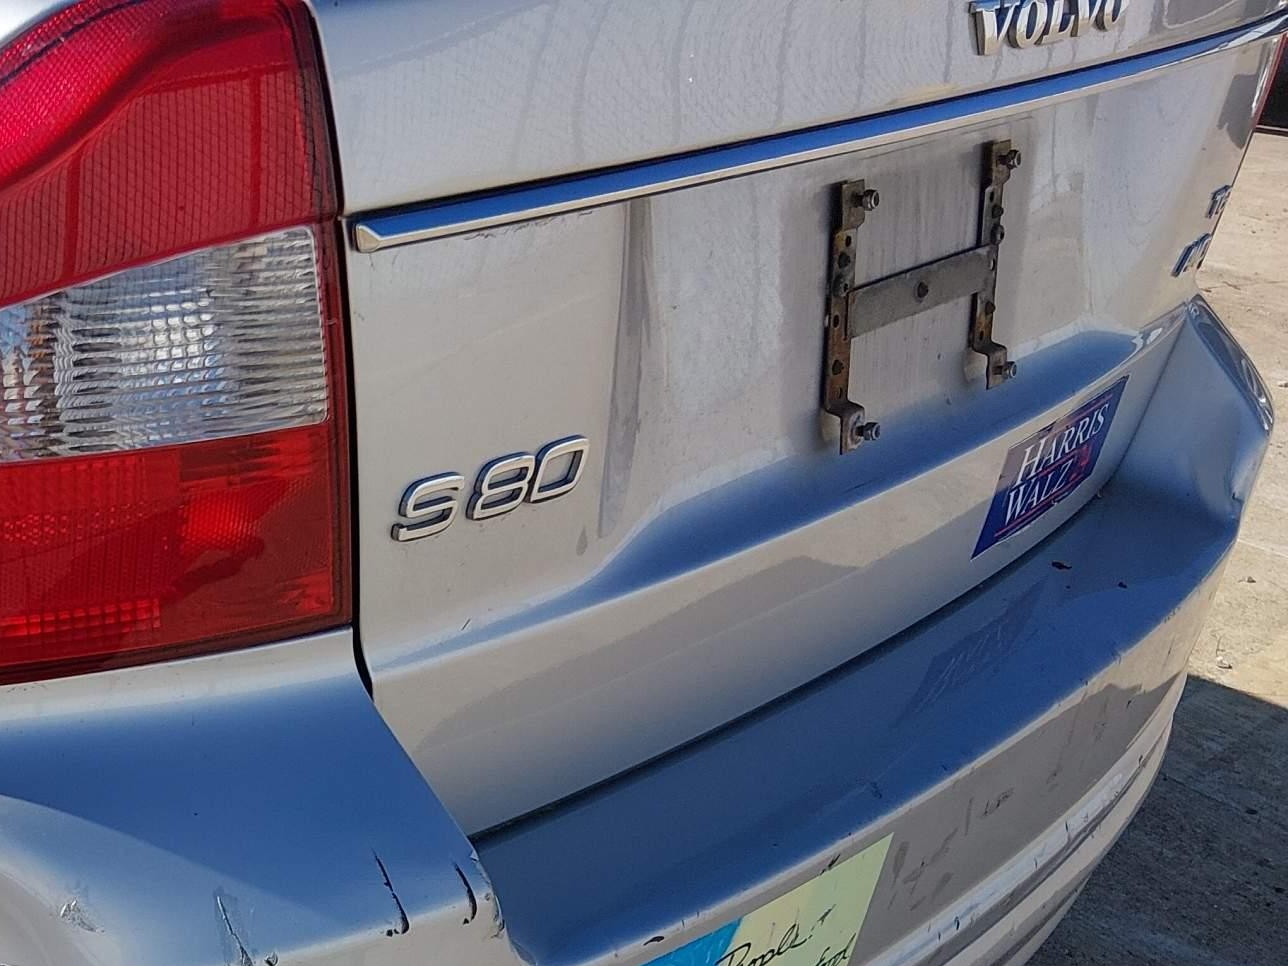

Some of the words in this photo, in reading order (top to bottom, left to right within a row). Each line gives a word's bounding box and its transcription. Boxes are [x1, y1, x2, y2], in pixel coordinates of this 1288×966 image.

[970, 0, 1128, 55] VOLVO
[1013, 403, 1109, 487] HARRIS
[391, 434, 589, 541] S80
[1005, 457, 1074, 525] WALZ
